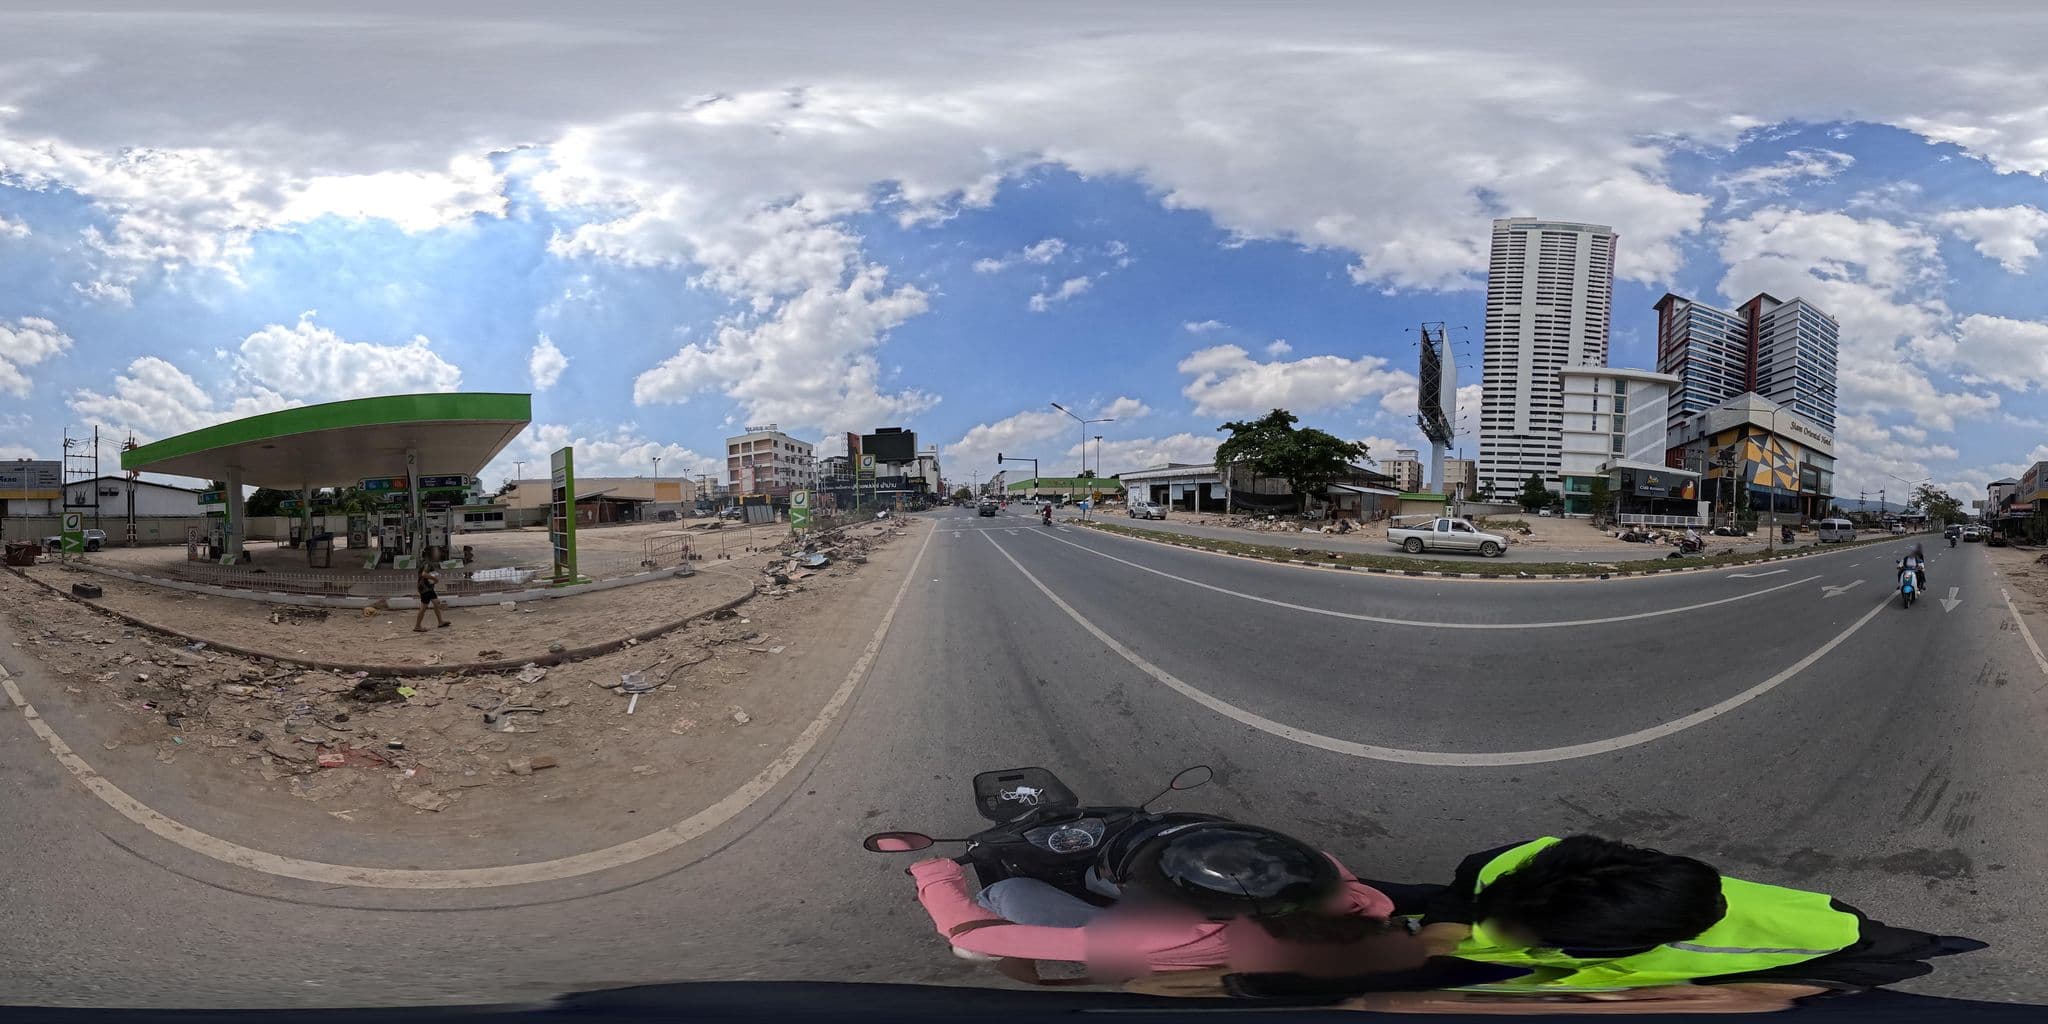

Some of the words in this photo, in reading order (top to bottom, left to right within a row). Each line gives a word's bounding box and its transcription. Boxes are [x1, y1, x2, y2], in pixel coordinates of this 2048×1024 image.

[408, 455, 414, 464] 2
[360, 480, 365, 490] 2
[463, 476, 469, 485] 3
